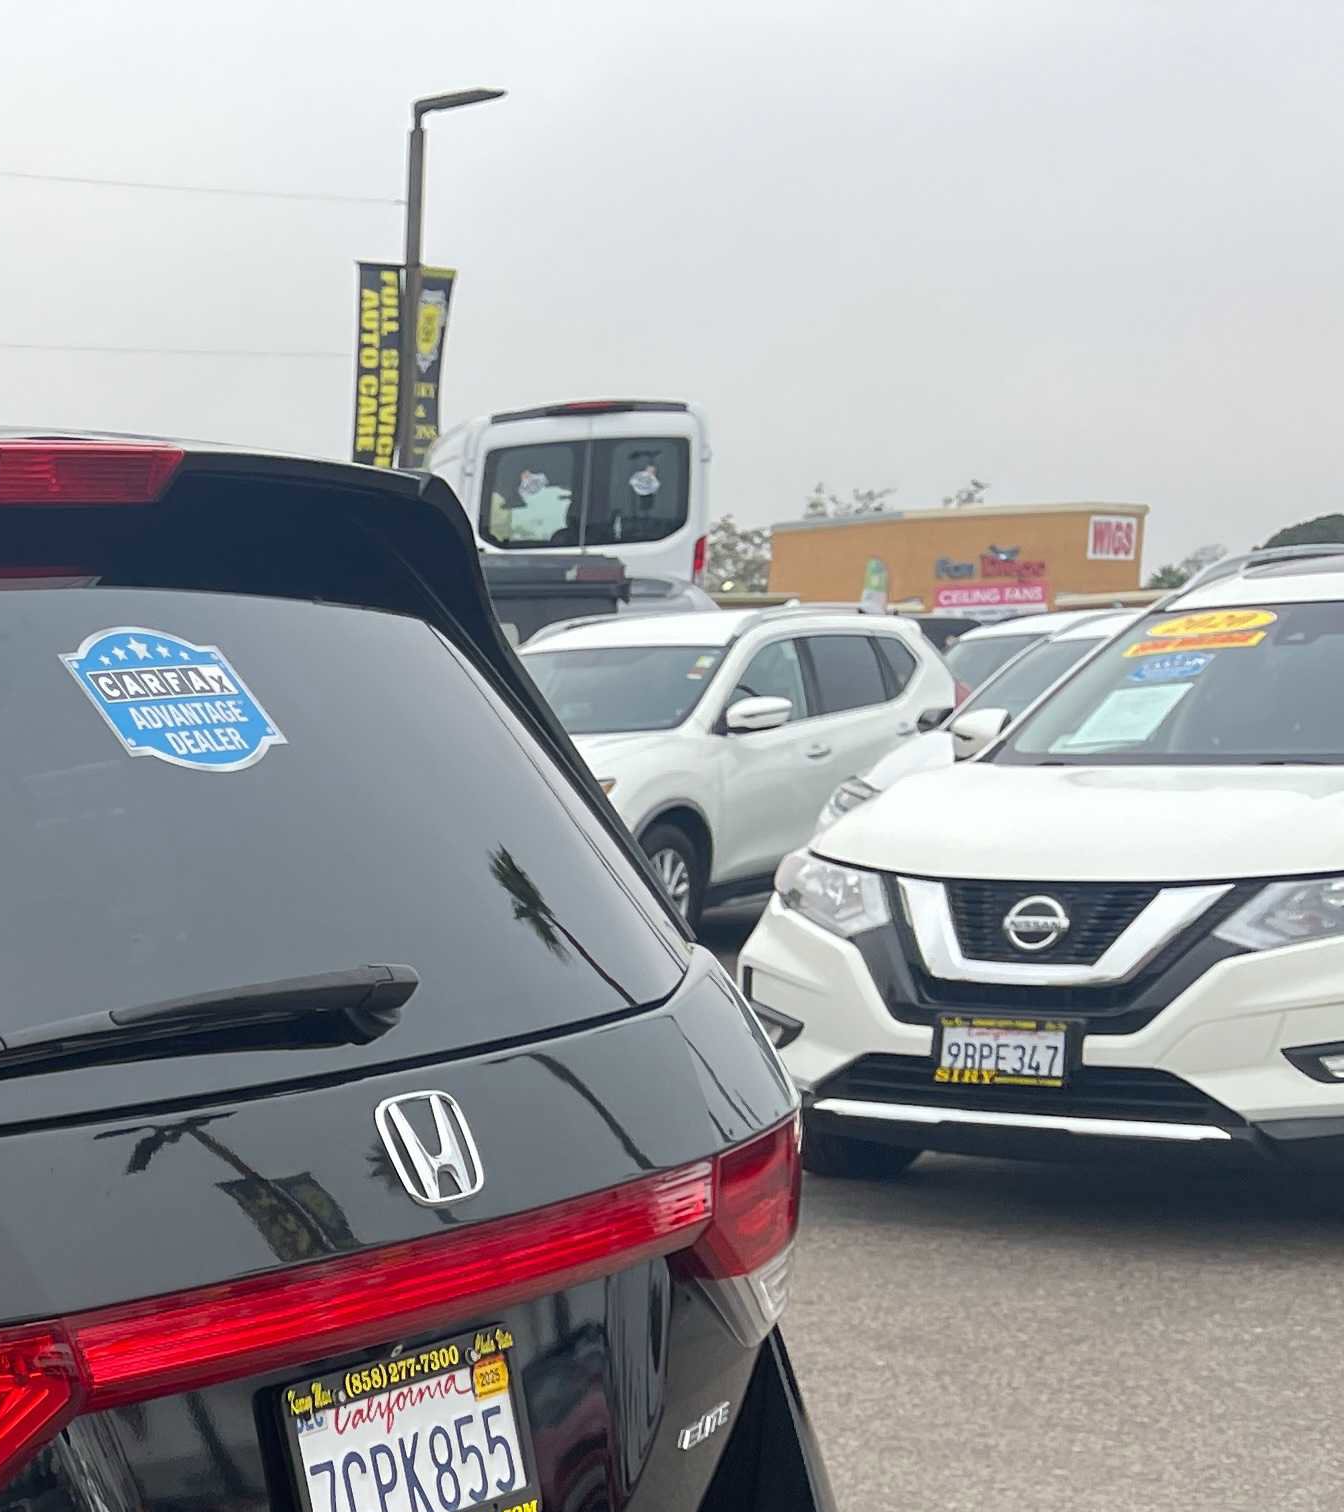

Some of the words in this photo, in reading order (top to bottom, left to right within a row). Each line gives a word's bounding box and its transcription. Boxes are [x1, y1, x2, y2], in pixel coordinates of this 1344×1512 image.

[379, 271, 399, 336] FULL
[359, 287, 379, 369] AUTO
[355, 373, 379, 452] CARE
[1093, 520, 1135, 557] WIGS
[938, 587, 1001, 606] CEILING
[1003, 585, 1043, 602] FANS
[92, 667, 236, 701] CARFAX
[127, 699, 249, 731] ADVANTAGE
[164, 727, 250, 756] DEALER
[935, 1066, 996, 1084] SIRY
[344, 1362, 389, 1398] (858)
[389, 1344, 460, 1383] 277-7300
[333, 1373, 472, 1435] California
